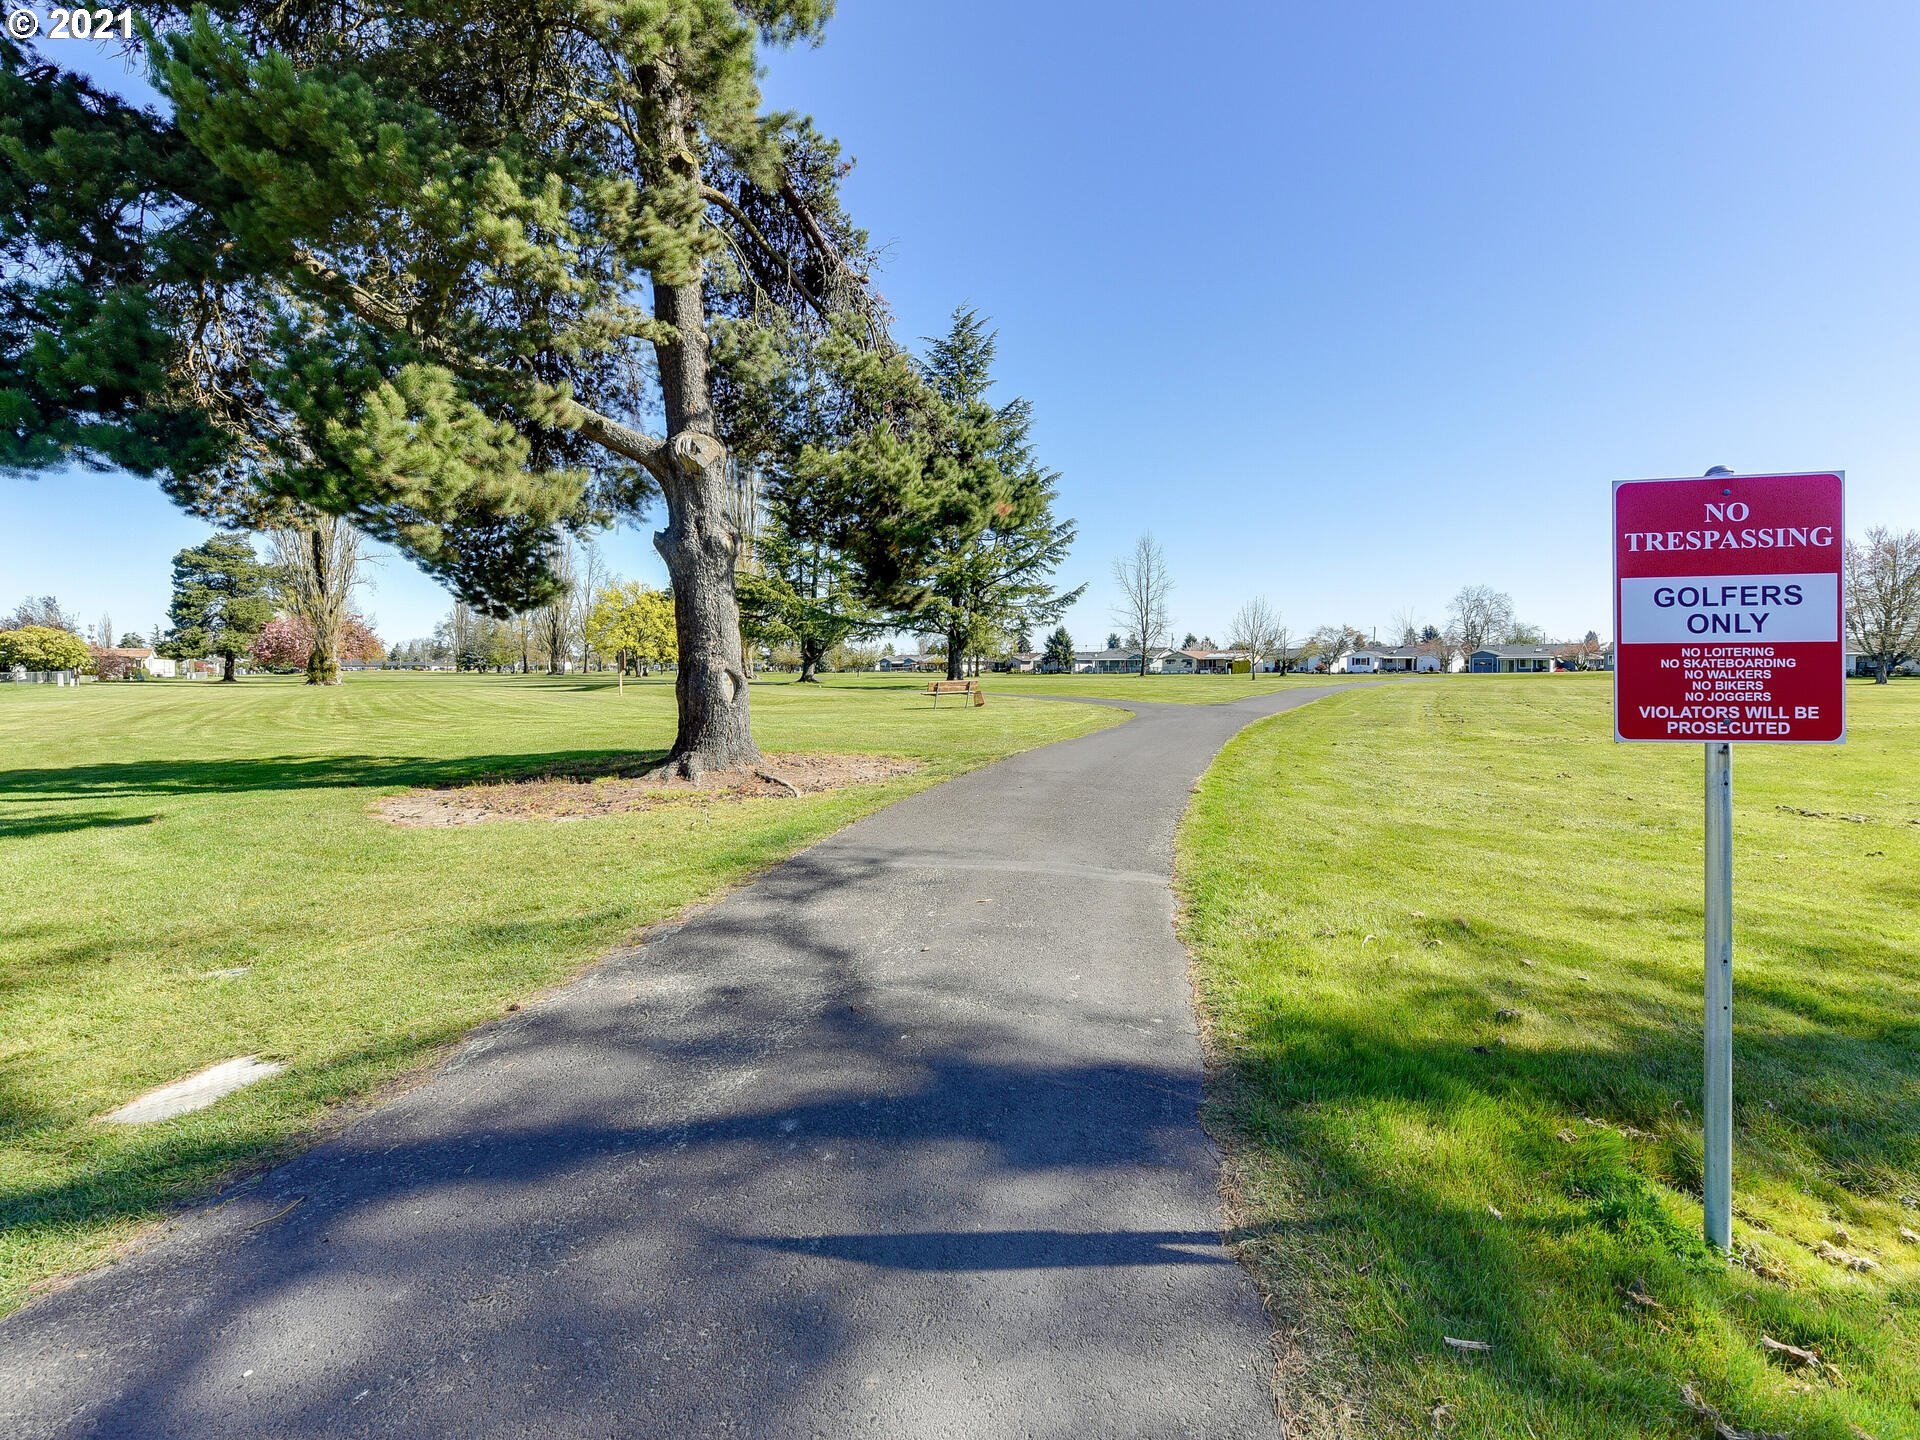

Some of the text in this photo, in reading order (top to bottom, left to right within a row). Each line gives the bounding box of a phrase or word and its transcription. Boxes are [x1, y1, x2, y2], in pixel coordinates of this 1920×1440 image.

[1704, 502, 1749, 522] NO
[1625, 526, 1834, 552] TRESPASSING
[1654, 585, 1803, 607] GOLFERS
[1687, 613, 1769, 634] ONLY
[1682, 647, 1774, 657] NO LOITERING
[1661, 658, 1796, 668] NO SKATEBOARDING
[1685, 670, 1771, 679] NO WALKERS
[1693, 681, 1763, 690] NO BIKERS
[1685, 692, 1771, 701] NO JOGGERS
[1639, 706, 1819, 718] VIOLATORS WILL BE
[1667, 722, 1790, 734] PROSECUTED
